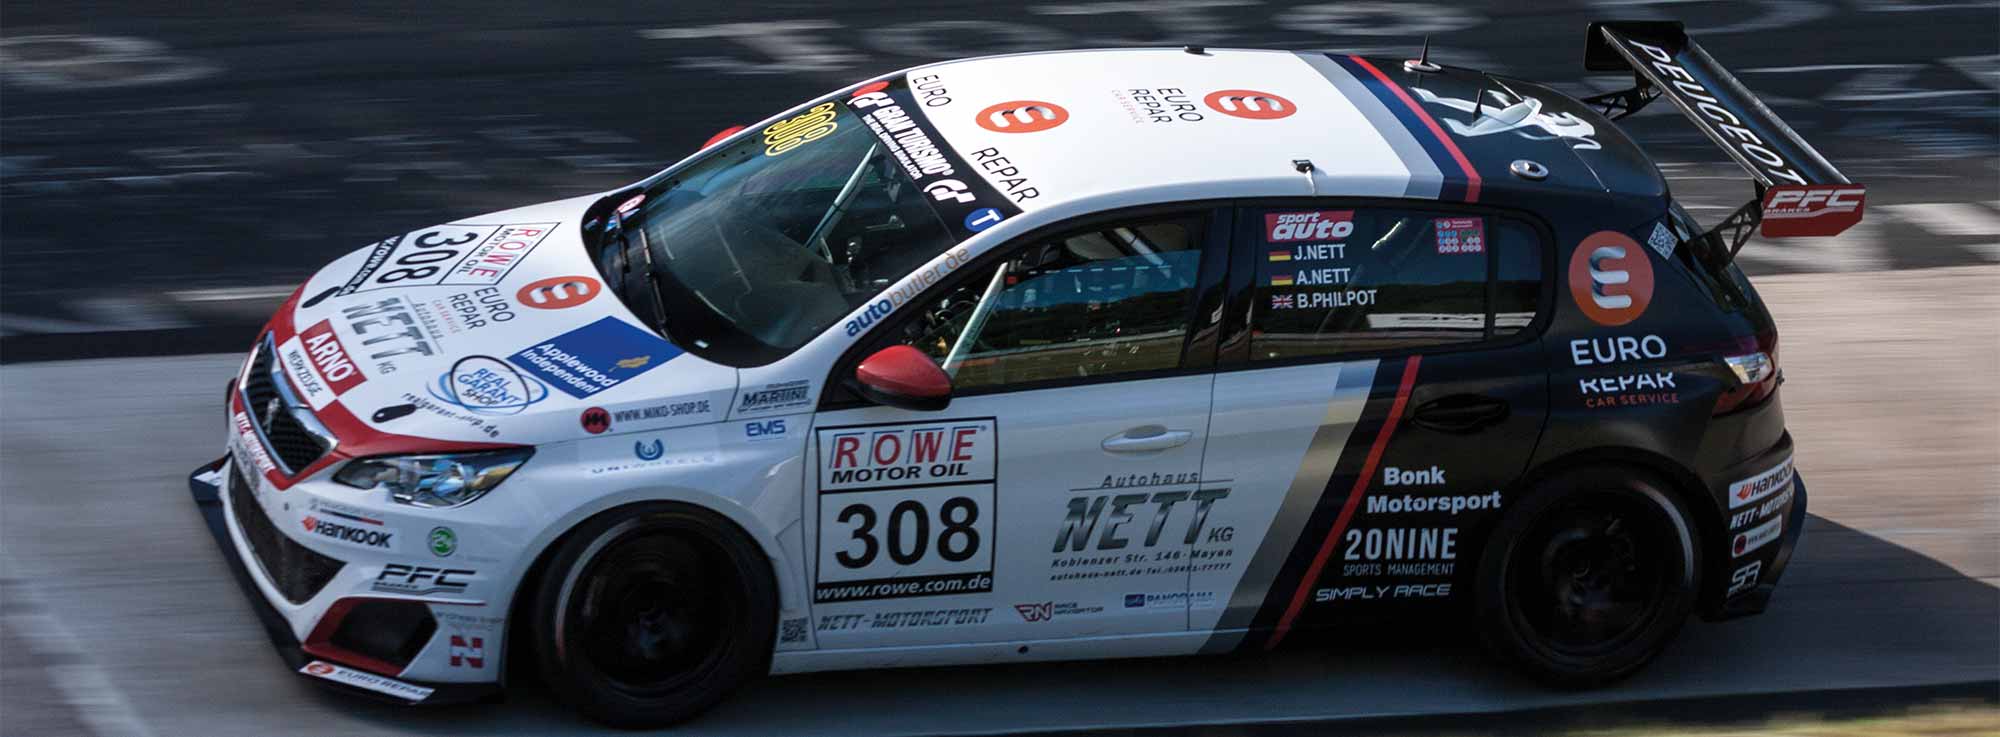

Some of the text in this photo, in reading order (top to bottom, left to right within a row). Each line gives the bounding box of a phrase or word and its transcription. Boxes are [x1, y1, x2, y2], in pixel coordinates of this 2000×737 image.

[913, 75, 952, 107] EURO
[1128, 88, 1172, 124] REPAR
[1157, 87, 1203, 123] EURO
[1629, 39, 1808, 186] PEUGEOT
[763, 102, 838, 156] 308
[872, 105, 917, 133] GRAN
[894, 149, 923, 180] SIMULATOR
[971, 147, 1040, 203] REPAR
[1764, 207, 1810, 215] BRAKES
[1767, 188, 1866, 209] PFC
[1272, 220, 1354, 240] auto
[1277, 212, 1321, 225] sport
[376, 231, 479, 284] 308
[457, 228, 514, 275] MOTOR OIL
[469, 228, 541, 279] ROWE
[1294, 244, 1345, 261] J.NETT
[1296, 267, 1351, 286] A.NETT
[474, 287, 515, 322] EURO
[845, 249, 969, 337] autobutler.de
[1297, 290, 1377, 309] B.PHILPOT
[449, 293, 487, 330] REPAR
[342, 298, 434, 360] NETT
[306, 331, 352, 383] ARNO
[1570, 334, 1667, 366] EURO
[376, 361, 397, 376] KG
[473, 368, 511, 388] REAL
[521, 349, 602, 394] Independent
[538, 343, 620, 387] Applewood
[458, 374, 521, 404] GARANT
[462, 388, 498, 406] SHOP
[1586, 393, 1680, 408] CAR SERVICE
[613, 399, 712, 423] WWW.MIKO-SHOP.DE
[745, 420, 786, 437] EMS
[829, 426, 977, 469] ROWE
[831, 463, 968, 484] MOTOR OIL
[1100, 472, 1200, 489] Autohaus
[1384, 466, 1446, 486] Bonk
[1367, 490, 1502, 515] Motorsport
[836, 496, 980, 569] 308
[1052, 488, 1233, 553] NETT
[1208, 526, 1234, 543] KG
[1344, 528, 1458, 560] 20NINE
[1051, 555, 1121, 568] Koblenzer
[1124, 553, 1148, 564] Str.
[1343, 562, 1455, 577] SPORTS MANAGEMENT
[377, 563, 476, 587] PFC
[816, 574, 990, 599] www.rowe.com.de
[1316, 583, 1452, 602] SIMPLY RACE
[817, 607, 993, 631] NETT-MOTORSPORT
